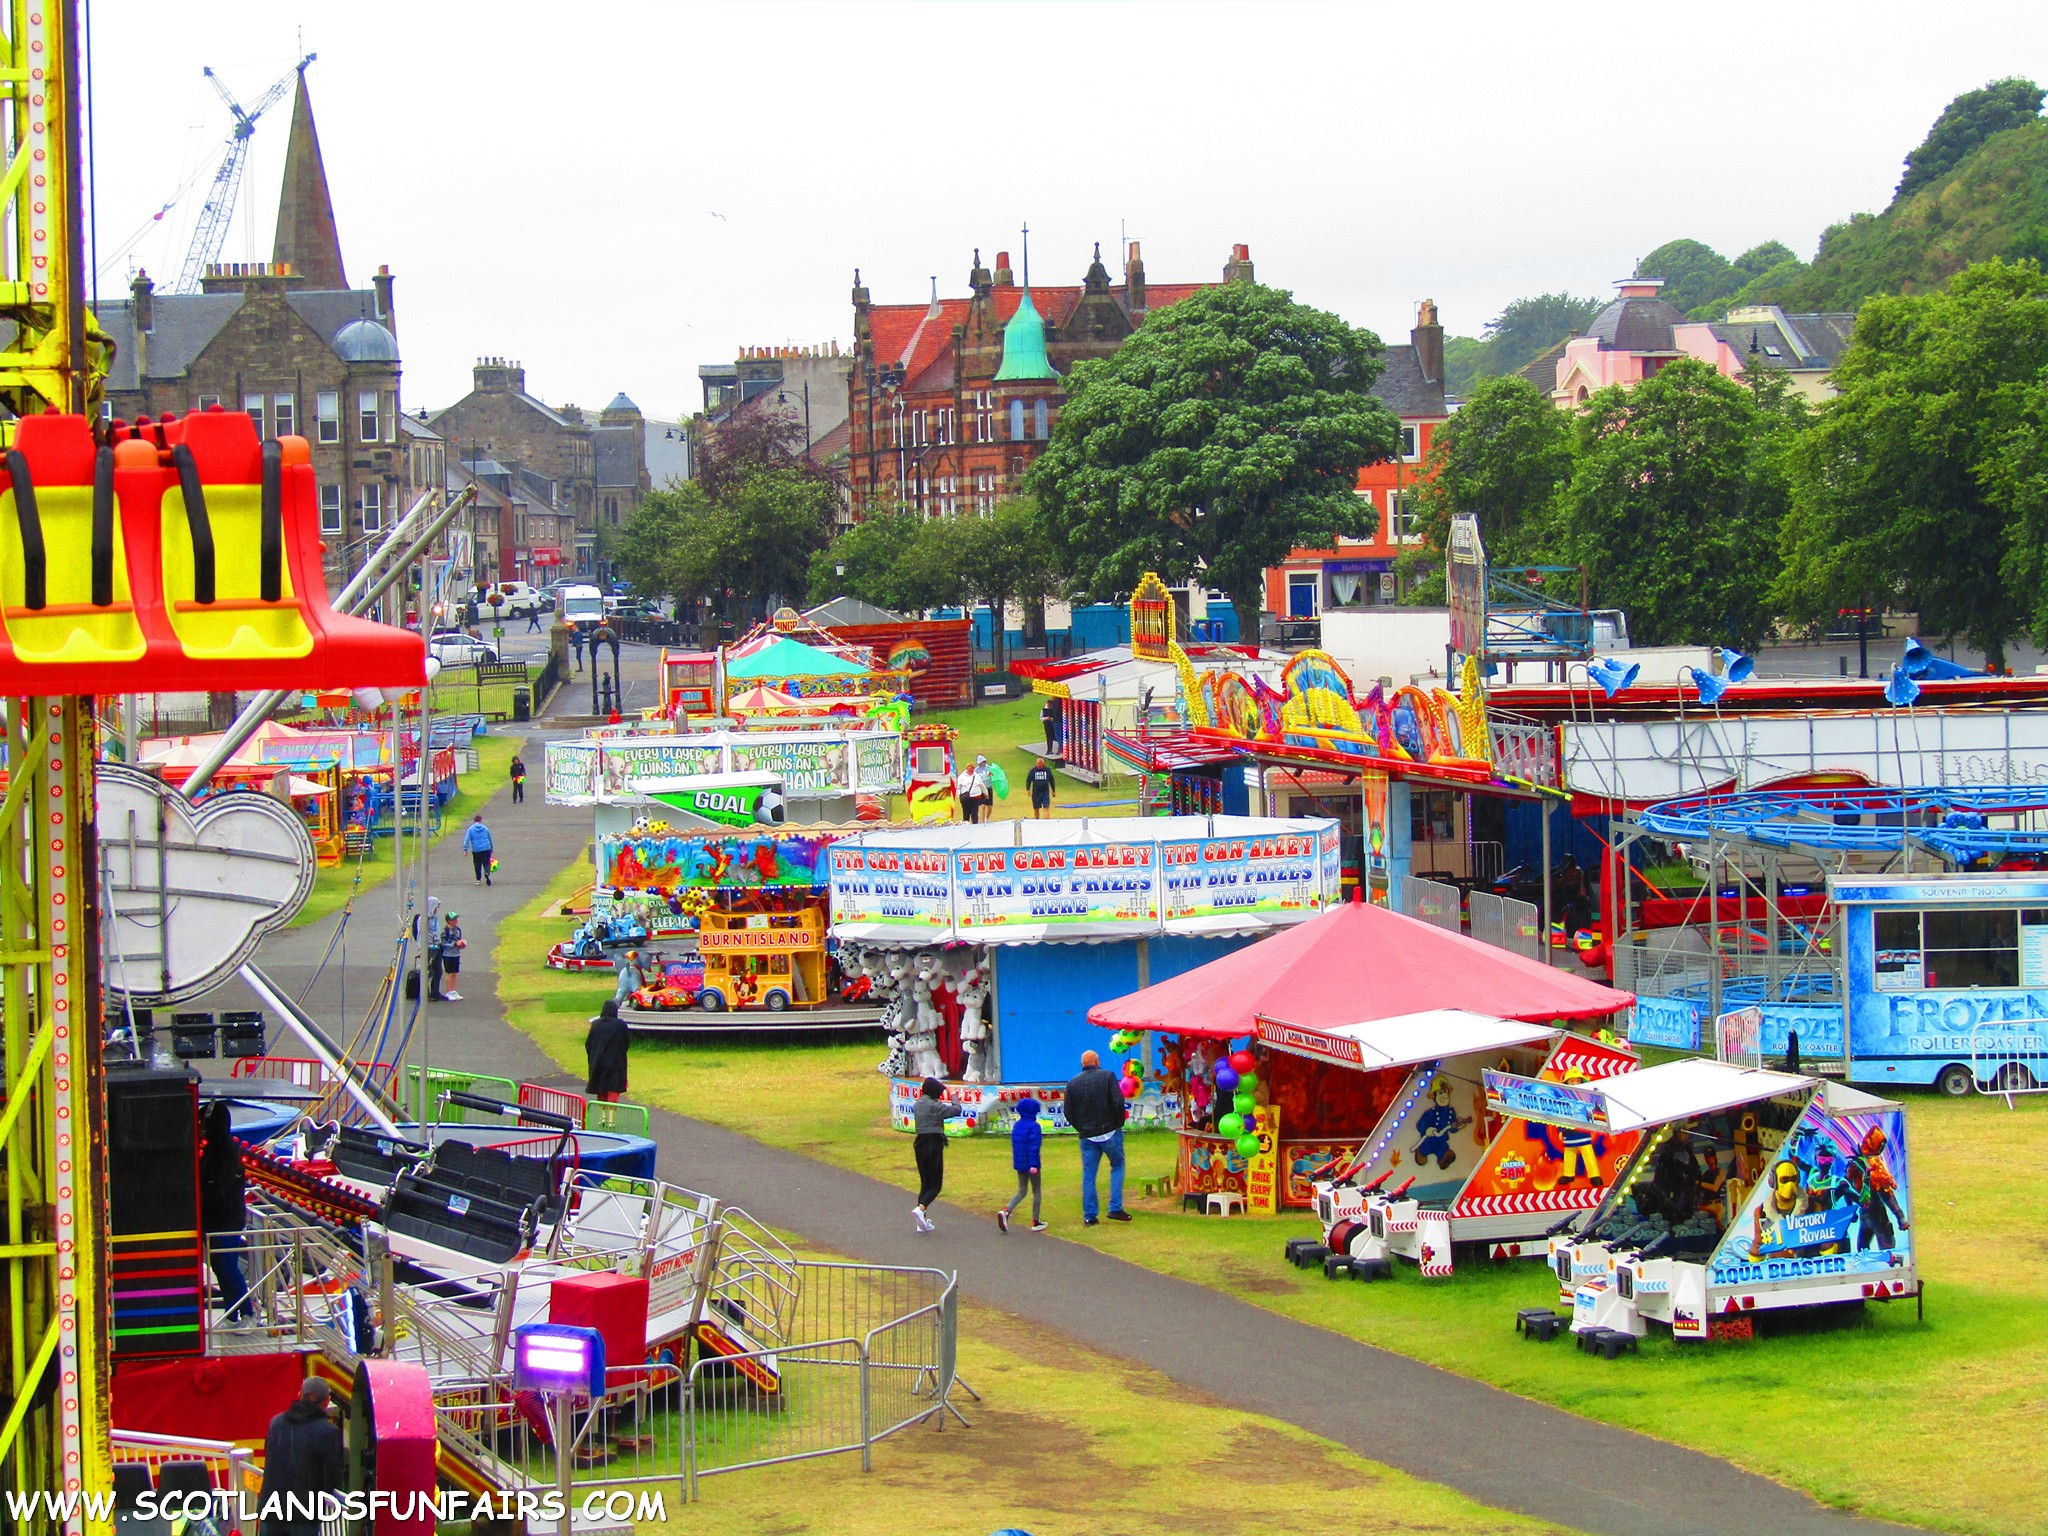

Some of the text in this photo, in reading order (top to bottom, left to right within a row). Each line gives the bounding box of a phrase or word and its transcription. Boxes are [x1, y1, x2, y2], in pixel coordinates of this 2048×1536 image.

[775, 621, 798, 632] BINGO
[624, 748, 703, 762] EVERY PLAYER
[750, 743, 826, 759] EVERY PLAYER
[640, 762, 669, 775] WINS
[763, 758, 792, 770] WINS
[554, 774, 587, 794] ELEPHANT
[694, 791, 751, 816] GOAL
[958, 846, 1153, 873] TIN CAN ALLEY
[1165, 844, 1199, 866] TIN
[1203, 841, 1246, 862] CAN
[1249, 836, 1314, 859] ALLEY
[834, 851, 947, 874] TIN CAN ALLEY
[1166, 868, 1202, 891] WIN
[1206, 865, 1238, 888] BIG
[1243, 861, 1314, 885] PRIZES
[834, 875, 948, 898] WIN BIG PRIZES
[960, 871, 1153, 899] WIN BIG PRIZES
[1922, 887, 2008, 897] SOUVENIR PHOTOS
[1212, 887, 1257, 908] HERE
[881, 899, 915, 918] HERE
[1030, 897, 1088, 917] HERE
[652, 916, 690, 929] ELEPHA
[702, 932, 811, 947] BURNTISLAND
[1638, 1004, 1690, 1035] FROZEN
[1287, 1030, 1329, 1050] AQUA BLASTER
[1772, 1043, 1839, 1052] ROLR COASTER
[1909, 1035, 2044, 1051] ROLLER COASTER
[897, 1083, 910, 1098] TIN
[998, 1088, 1066, 1102] TIN CA
[1518, 1092, 1574, 1116] AQUA BLASTER
[1251, 1172, 1271, 1183] PRIZE
[1500, 1167, 1525, 1178] SAM
[1250, 1185, 1272, 1195] EVERY
[1254, 1197, 1270, 1208] TIME
[652, 1259, 674, 1279] SAFETY
[675, 1250, 696, 1269] NOTICE
[1714, 1257, 1846, 1285] AQUA BLASTER
